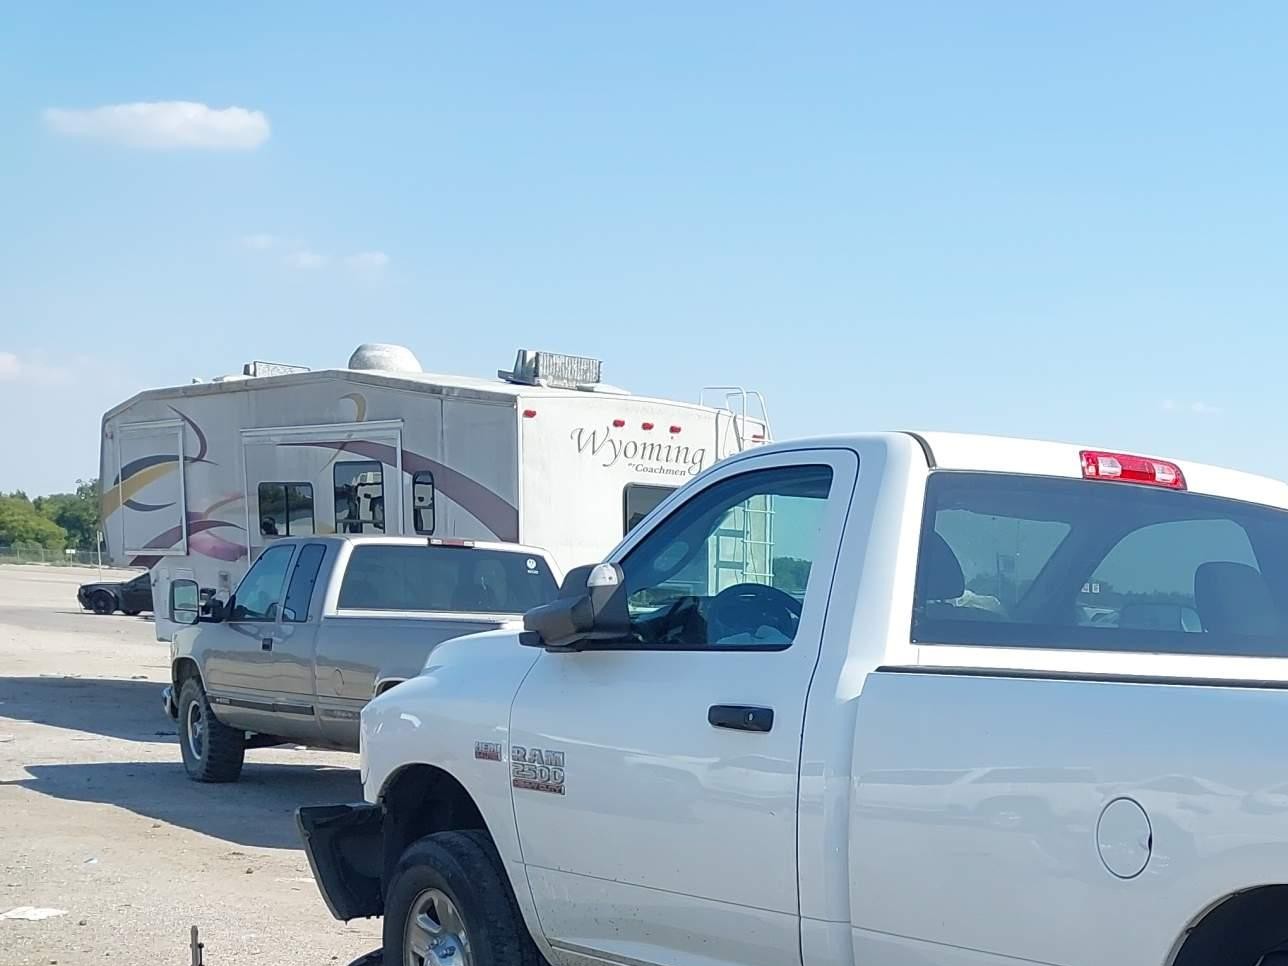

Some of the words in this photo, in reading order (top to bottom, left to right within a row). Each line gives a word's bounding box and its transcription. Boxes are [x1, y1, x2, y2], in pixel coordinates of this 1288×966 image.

[571, 426, 705, 476] Wyoming
[635, 463, 686, 476] Coachmen
[511, 746, 565, 767] RAM
[511, 762, 565, 785] 2500
